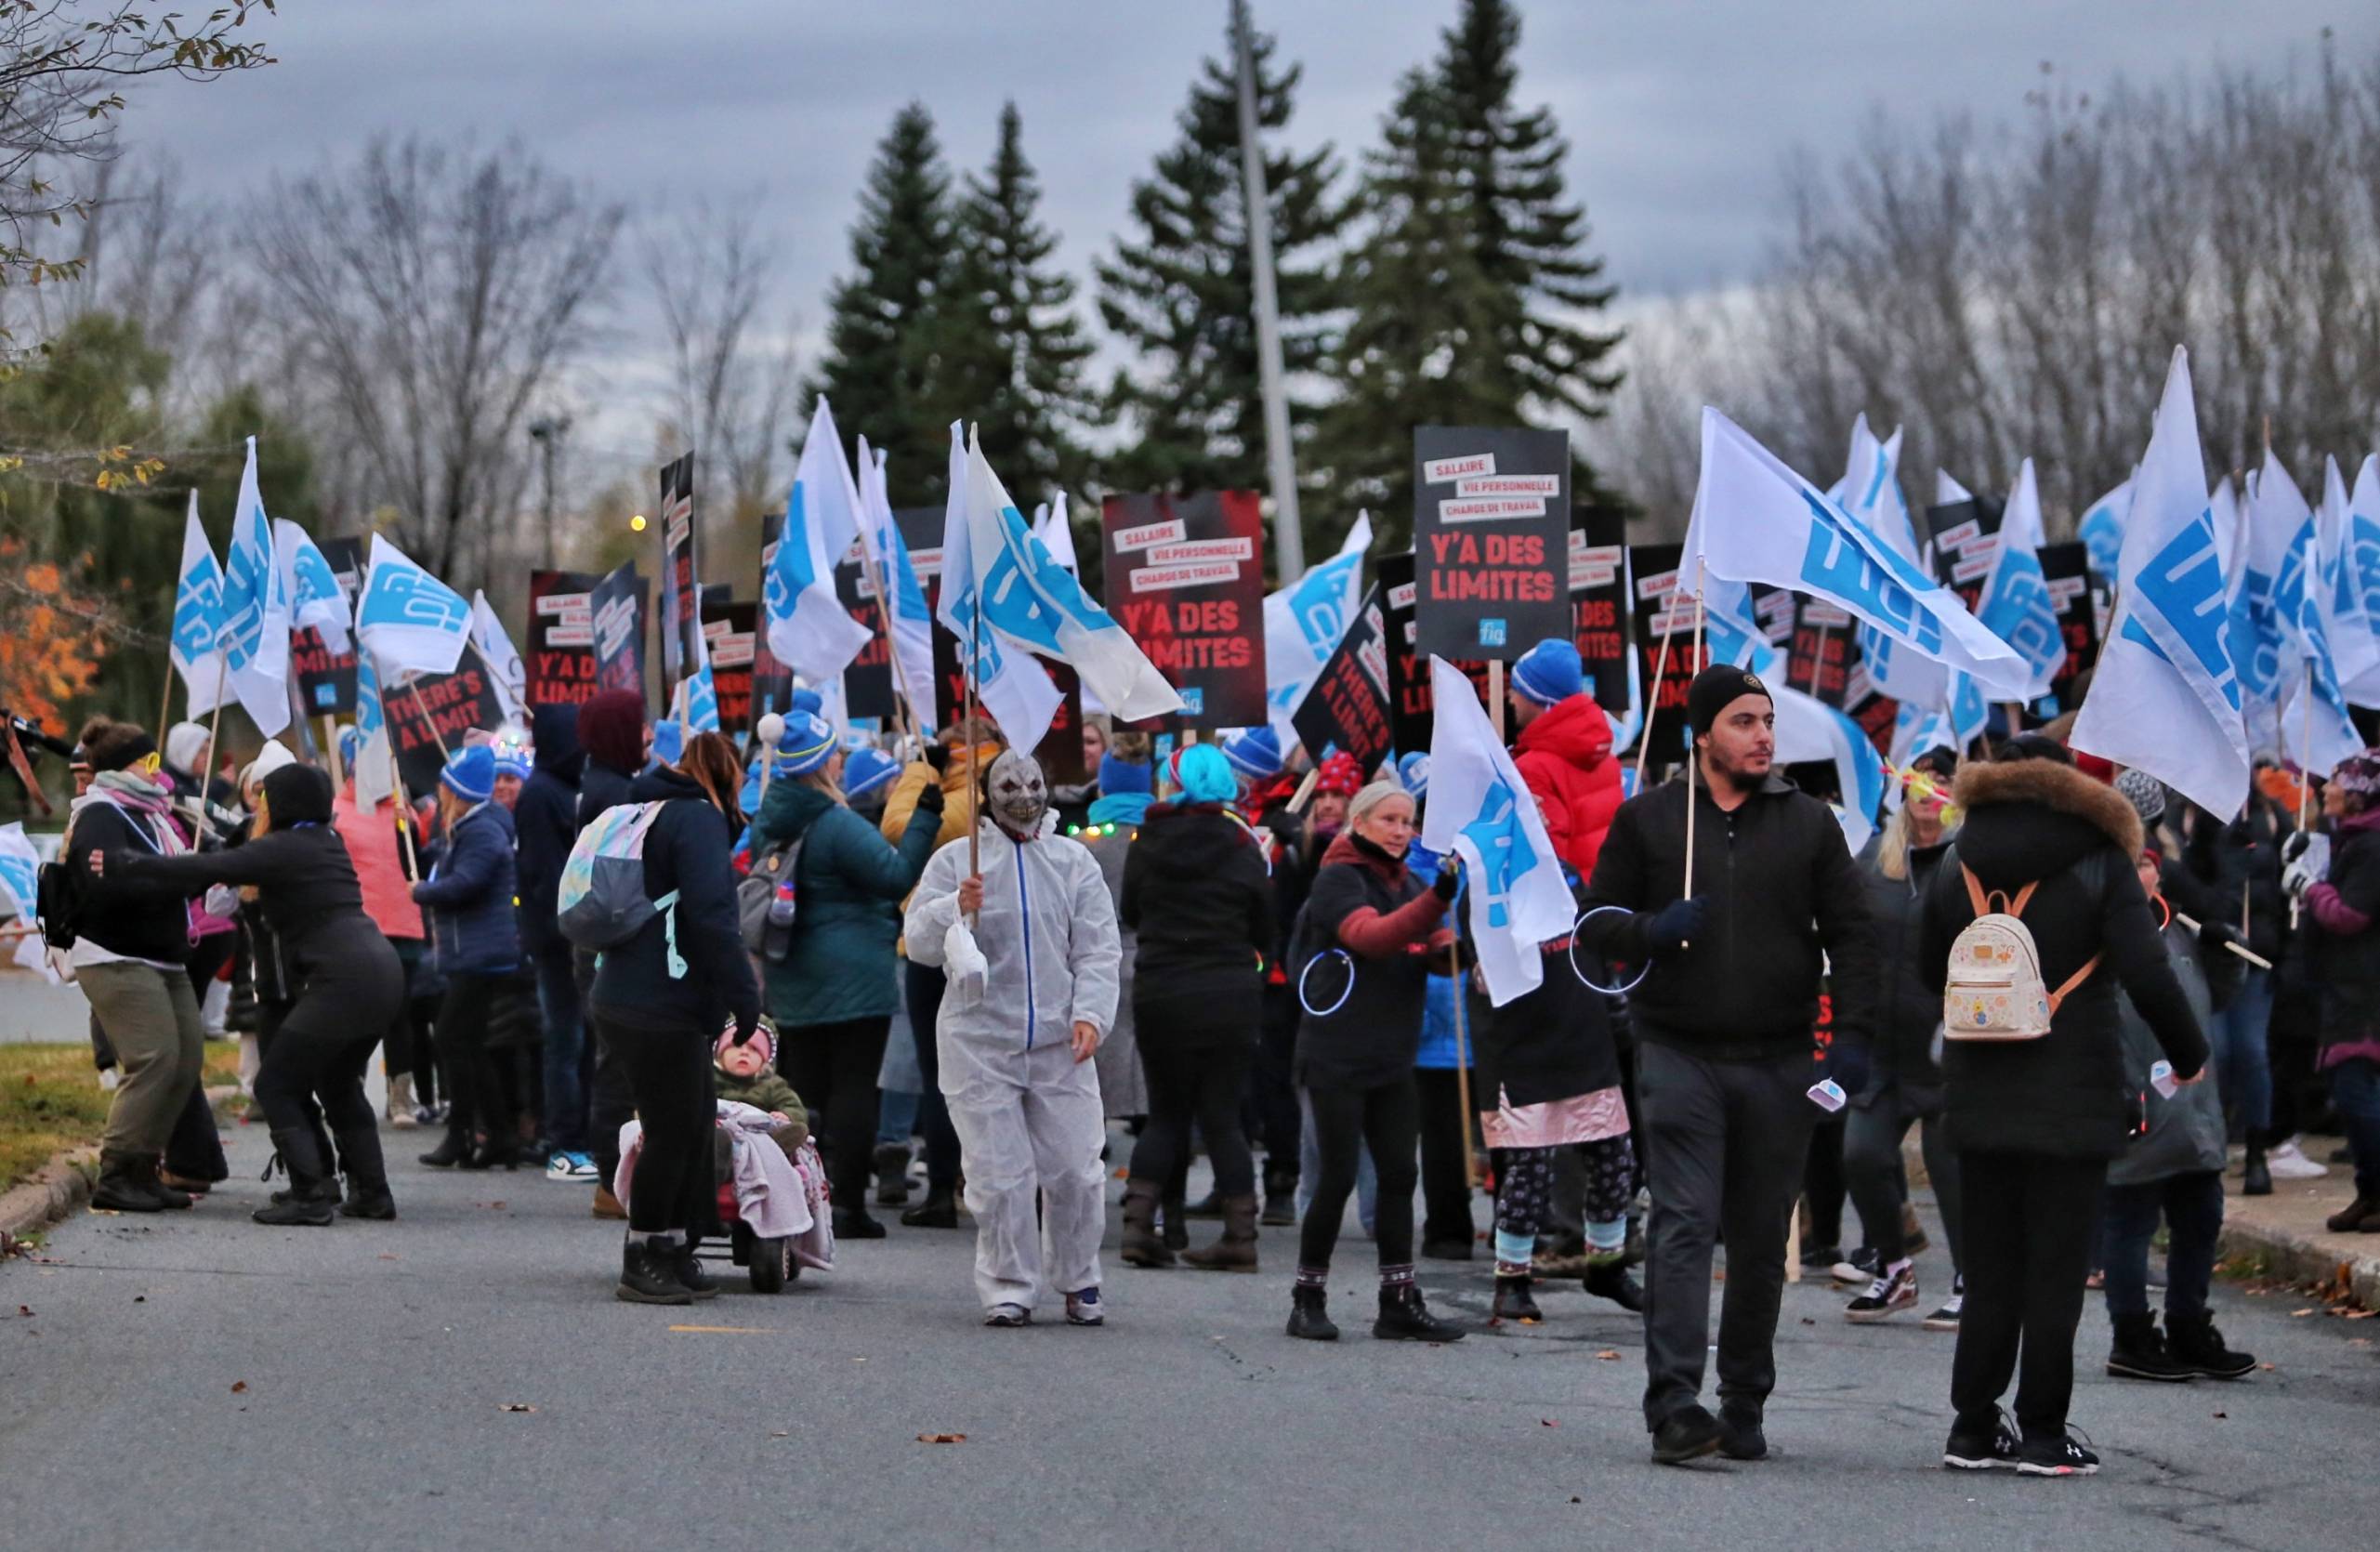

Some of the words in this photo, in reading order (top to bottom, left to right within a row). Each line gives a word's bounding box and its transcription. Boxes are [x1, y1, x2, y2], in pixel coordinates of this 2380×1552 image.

[1436, 459, 1485, 476] SALAIRE
[1464, 483, 1479, 492] VIE
[1481, 480, 1553, 492] PERSONNELLE
[1446, 505, 1486, 516] CHARGE
[1487, 504, 1499, 512] DE
[1502, 501, 1540, 511] TRAVAIL
[1124, 526, 1175, 545] SALAIRE
[1430, 532, 1479, 564] Y'A
[1485, 534, 1545, 566] DES
[1153, 549, 1170, 560] VIE
[1173, 544, 1246, 559] PERSONNELLE
[1137, 571, 1177, 585] CHARGE
[1178, 570, 1190, 580] DE
[1193, 564, 1233, 579] TRAVAIL
[1431, 569, 1555, 601] LIMITES
[1123, 599, 1173, 635] Y'A
[1177, 600, 1239, 633] DES
[1582, 600, 1616, 627] DES
[1140, 636, 1251, 669] IMITES
[387, 670, 482, 723] THERE'S
[400, 727, 419, 751] A
[420, 699, 482, 743] LIMIT
